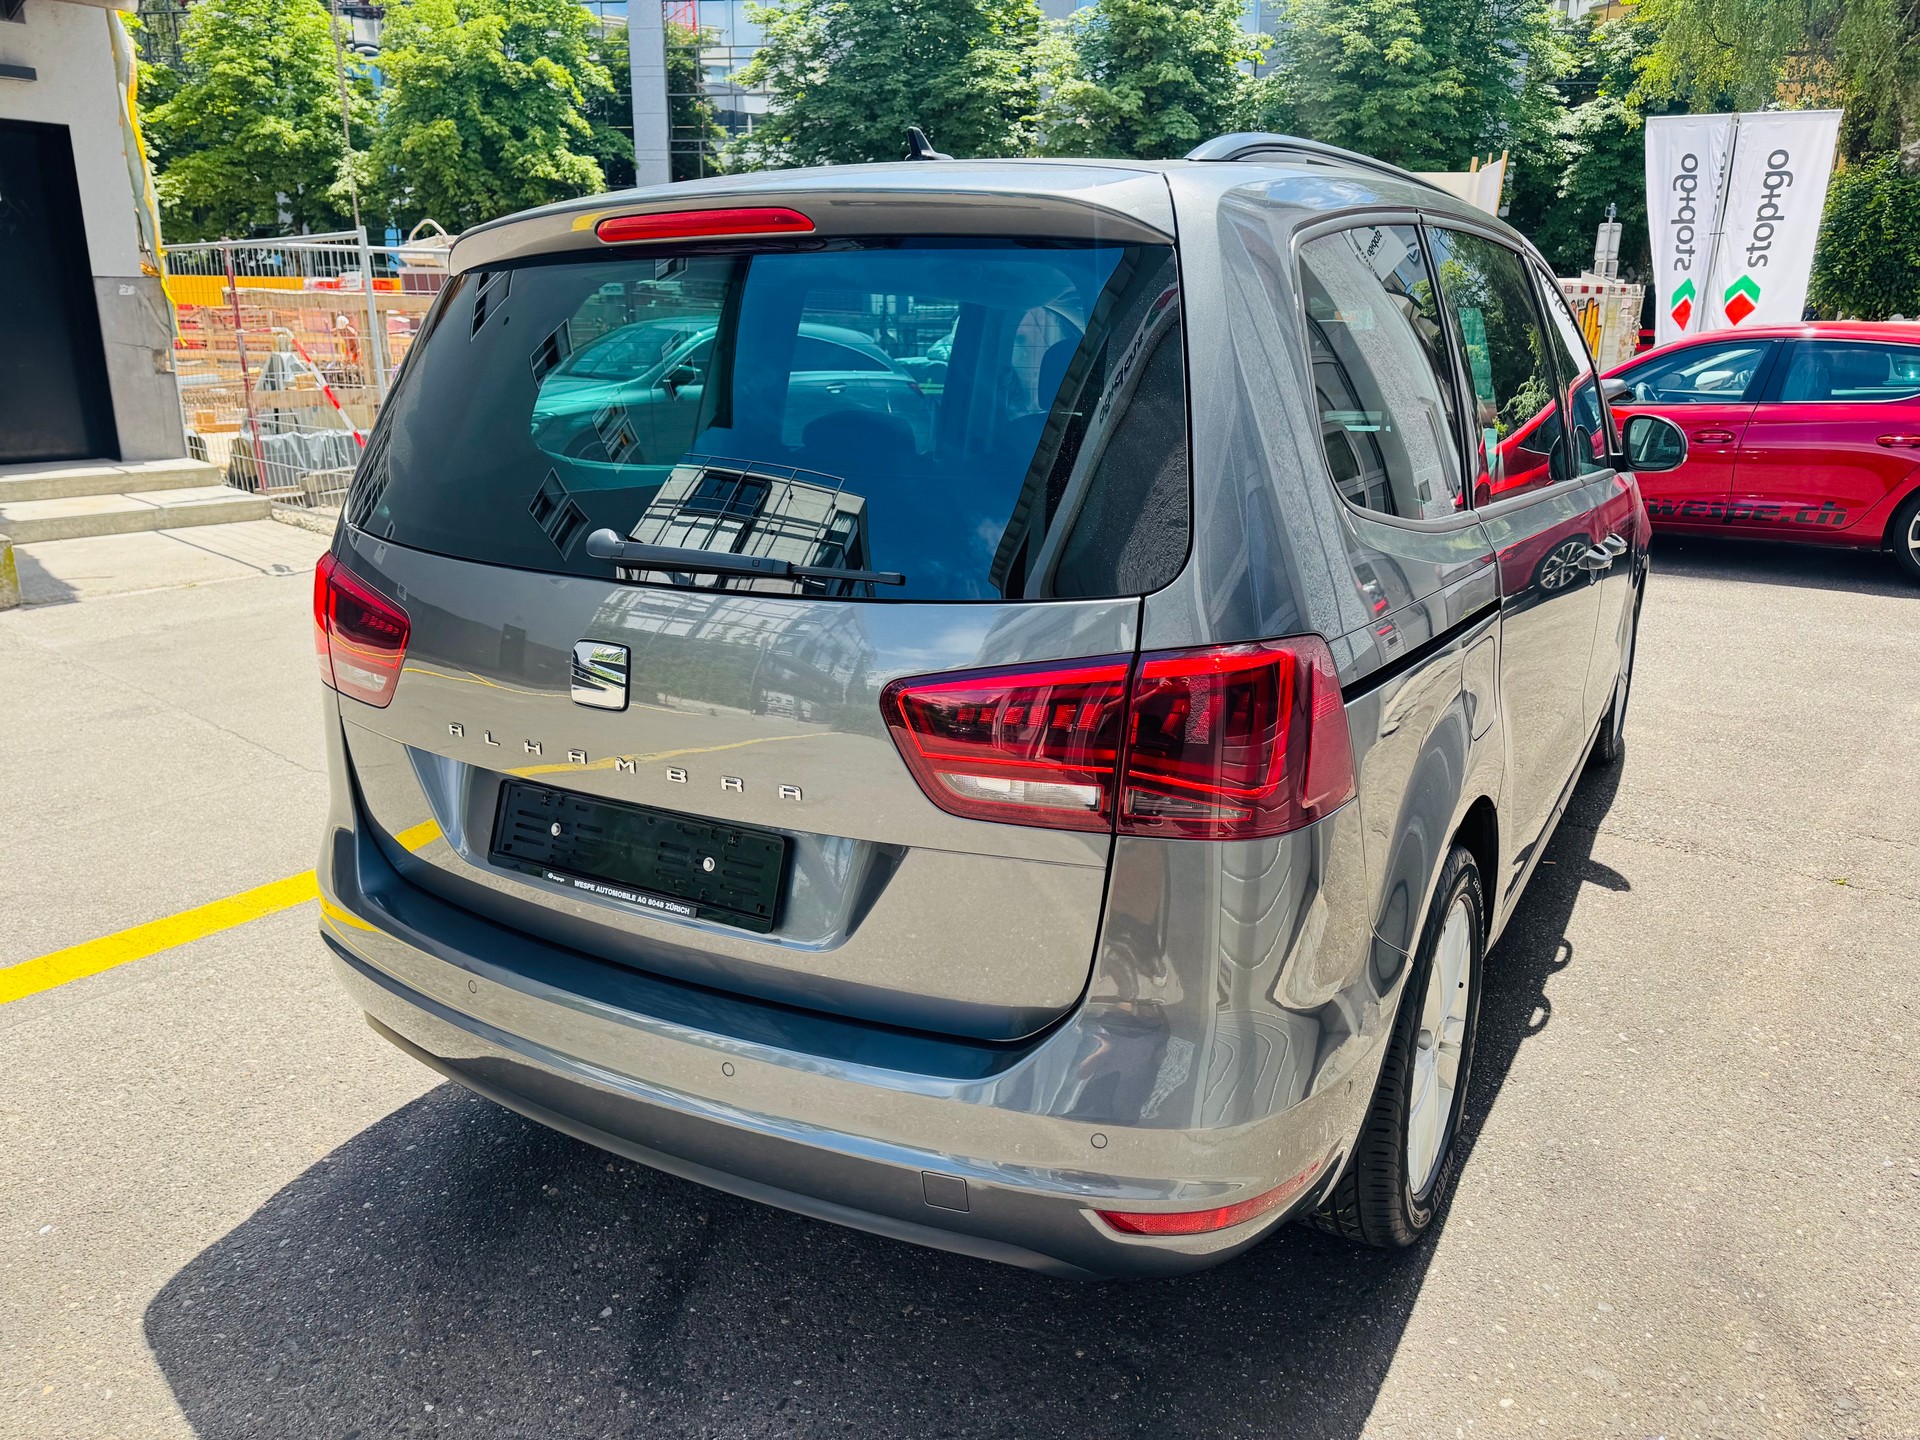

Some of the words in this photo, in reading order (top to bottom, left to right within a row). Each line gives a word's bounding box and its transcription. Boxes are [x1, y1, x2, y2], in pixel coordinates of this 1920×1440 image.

[1746, 149, 1793, 268] stop+go
[447, 721, 803, 802] ALHAMBRA
[574, 879, 595, 892] WESPE
[595, 885, 636, 902] AUTOMOBILE
[637, 895, 647, 904] AG
[647, 898, 664, 909] 8048
[665, 902, 690, 915] ZÜRICH
